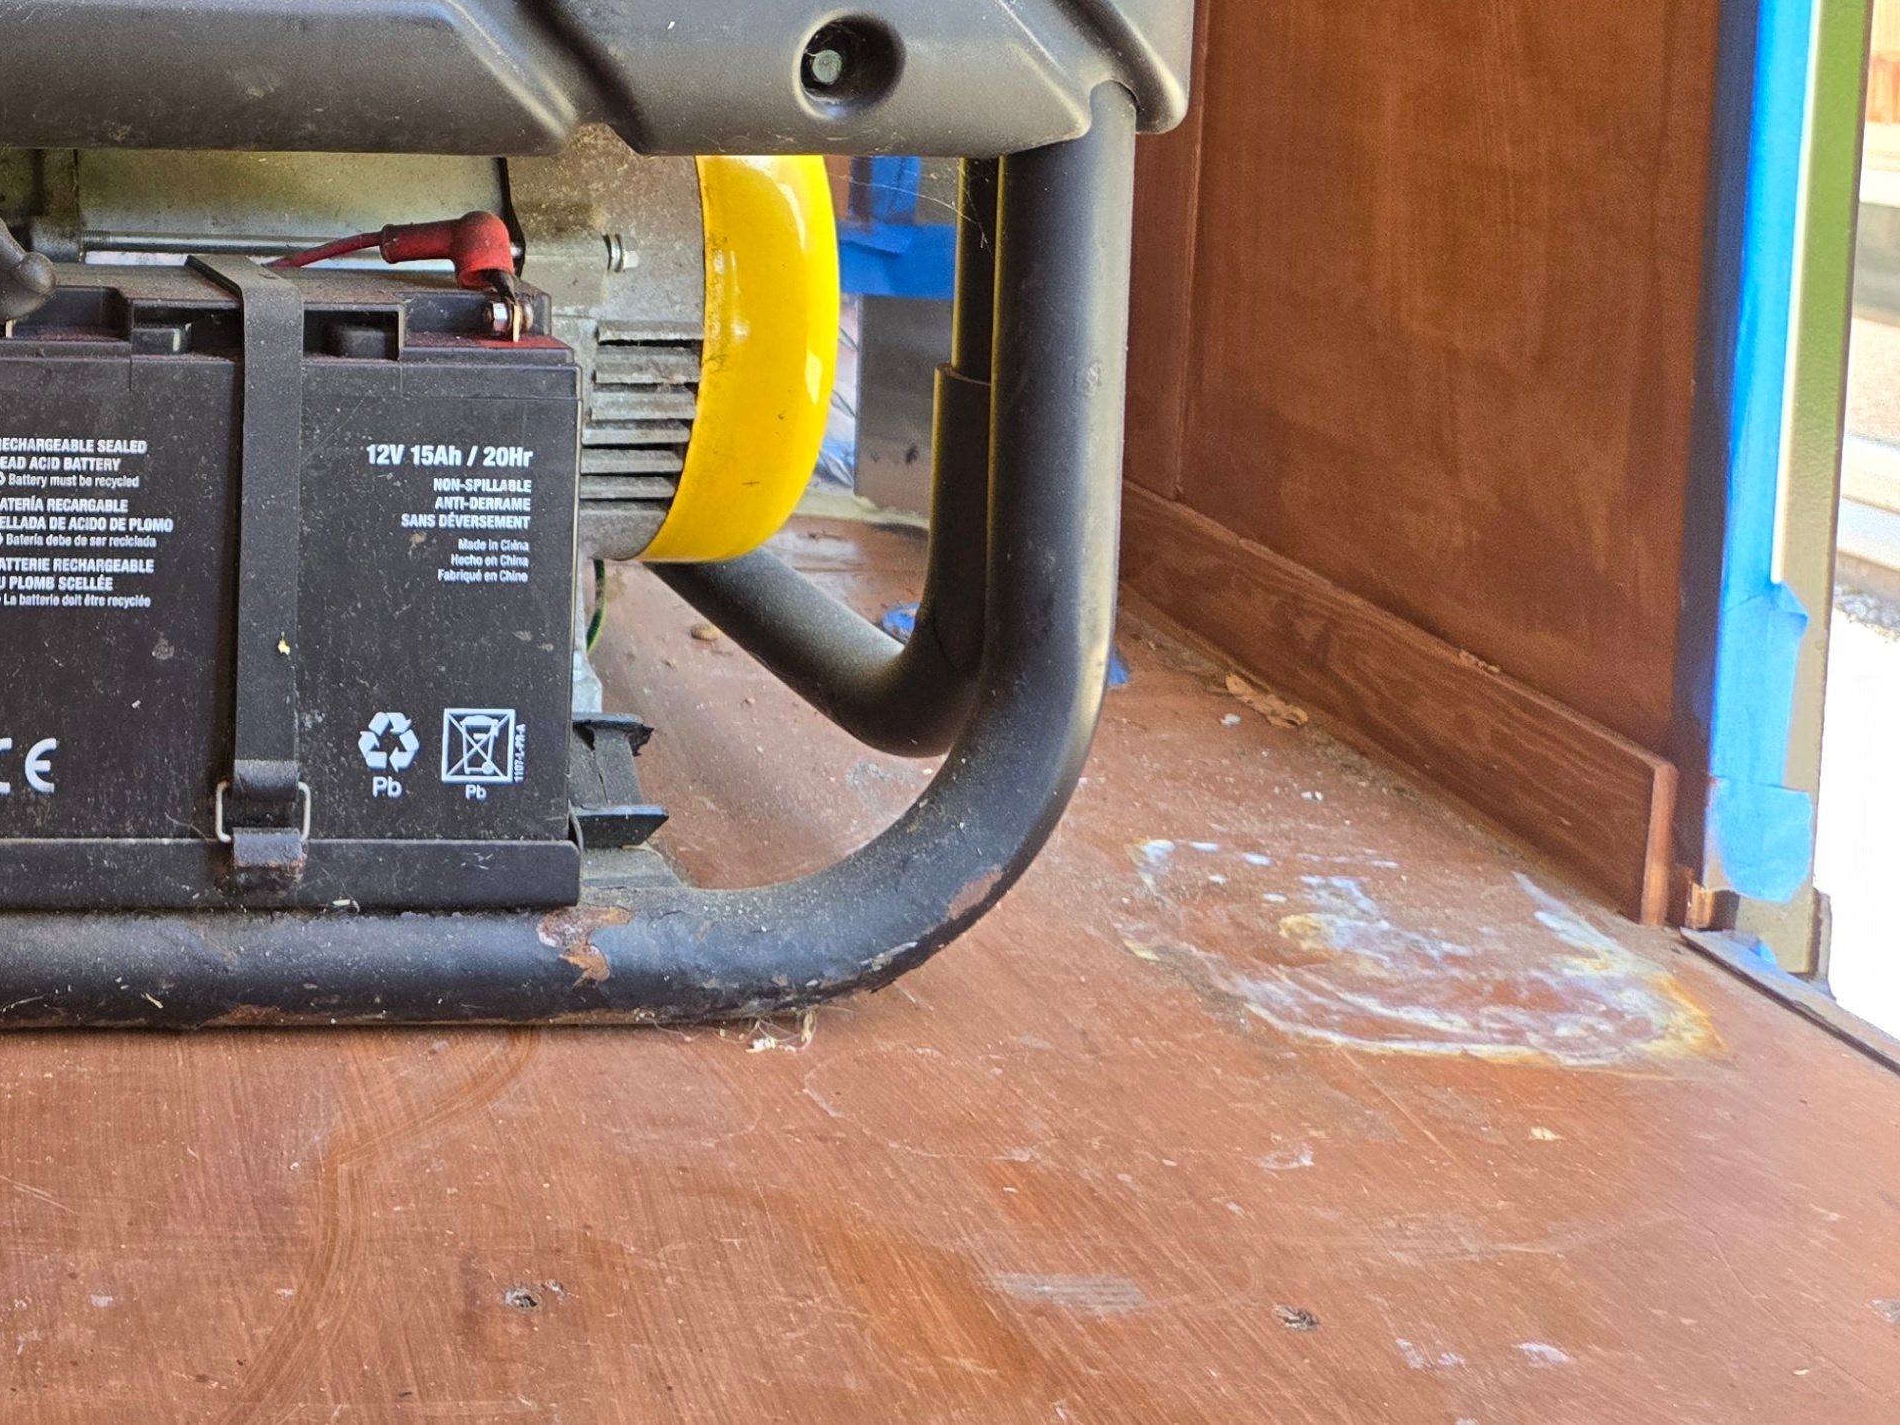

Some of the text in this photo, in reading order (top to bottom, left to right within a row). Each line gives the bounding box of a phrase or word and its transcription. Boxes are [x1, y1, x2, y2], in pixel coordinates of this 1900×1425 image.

[97, 440, 147, 454] SEALED
[366, 444, 533, 467] 12V 15Ah / 20Hr
[29, 457, 60, 470] ACID
[64, 457, 121, 471] BATTERY
[8, 474, 139, 489] Battery must be recycled
[433, 478, 532, 493] NON-SPILLABLE
[47, 499, 128, 513] RECARGABLE
[435, 496, 531, 511] ANTI-DERRAME
[49, 517, 66, 530] DE
[68, 518, 106, 531] ACIDO
[110, 518, 126, 531] DE
[129, 518, 173, 532] PLOMO
[401, 511, 530, 529] SANS DÉVERSEMENT
[6, 533, 156, 548] Batería debe de ser reciclada
[458, 538, 529, 552] Made in China
[53, 559, 154, 573] RECHARGEABLE
[451, 554, 529, 568] Hecho en China
[9, 577, 54, 590] PLOMB
[58, 575, 113, 591] SCELLÉE
[437, 569, 528, 584] Fabriqué en Chine
[3, 594, 151, 609] La batterie doit être recyclée
[372, 776, 403, 798] Pb
[465, 784, 487, 801] Pb
